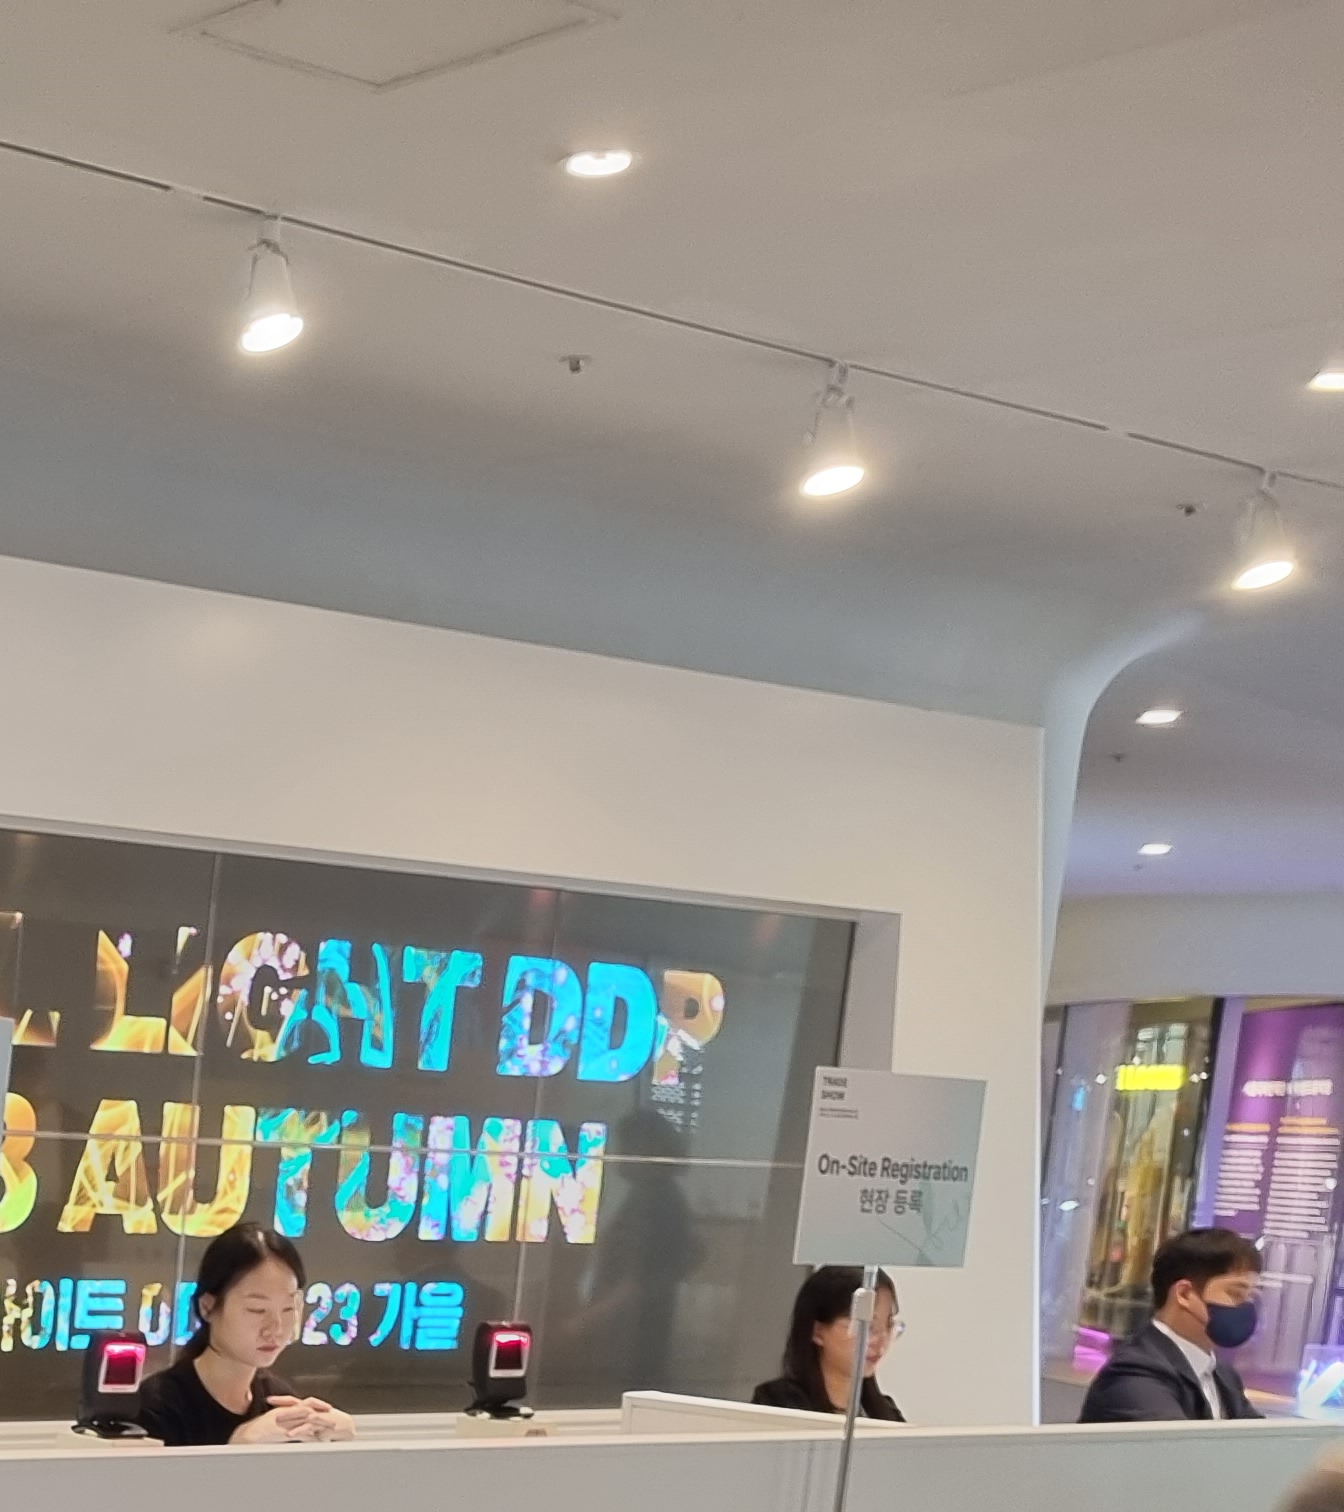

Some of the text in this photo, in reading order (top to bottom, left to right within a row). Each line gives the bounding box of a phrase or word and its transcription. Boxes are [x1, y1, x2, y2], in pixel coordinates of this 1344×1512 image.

[90, 925, 482, 1072] LIGHT
[497, 954, 725, 1085] DDP
[56, 1100, 609, 1244] AUTUMN
[818, 1152, 968, 1184] On-Site Registration
[302, 1282, 360, 1345] 23
[368, 1281, 464, 1349] 가을
